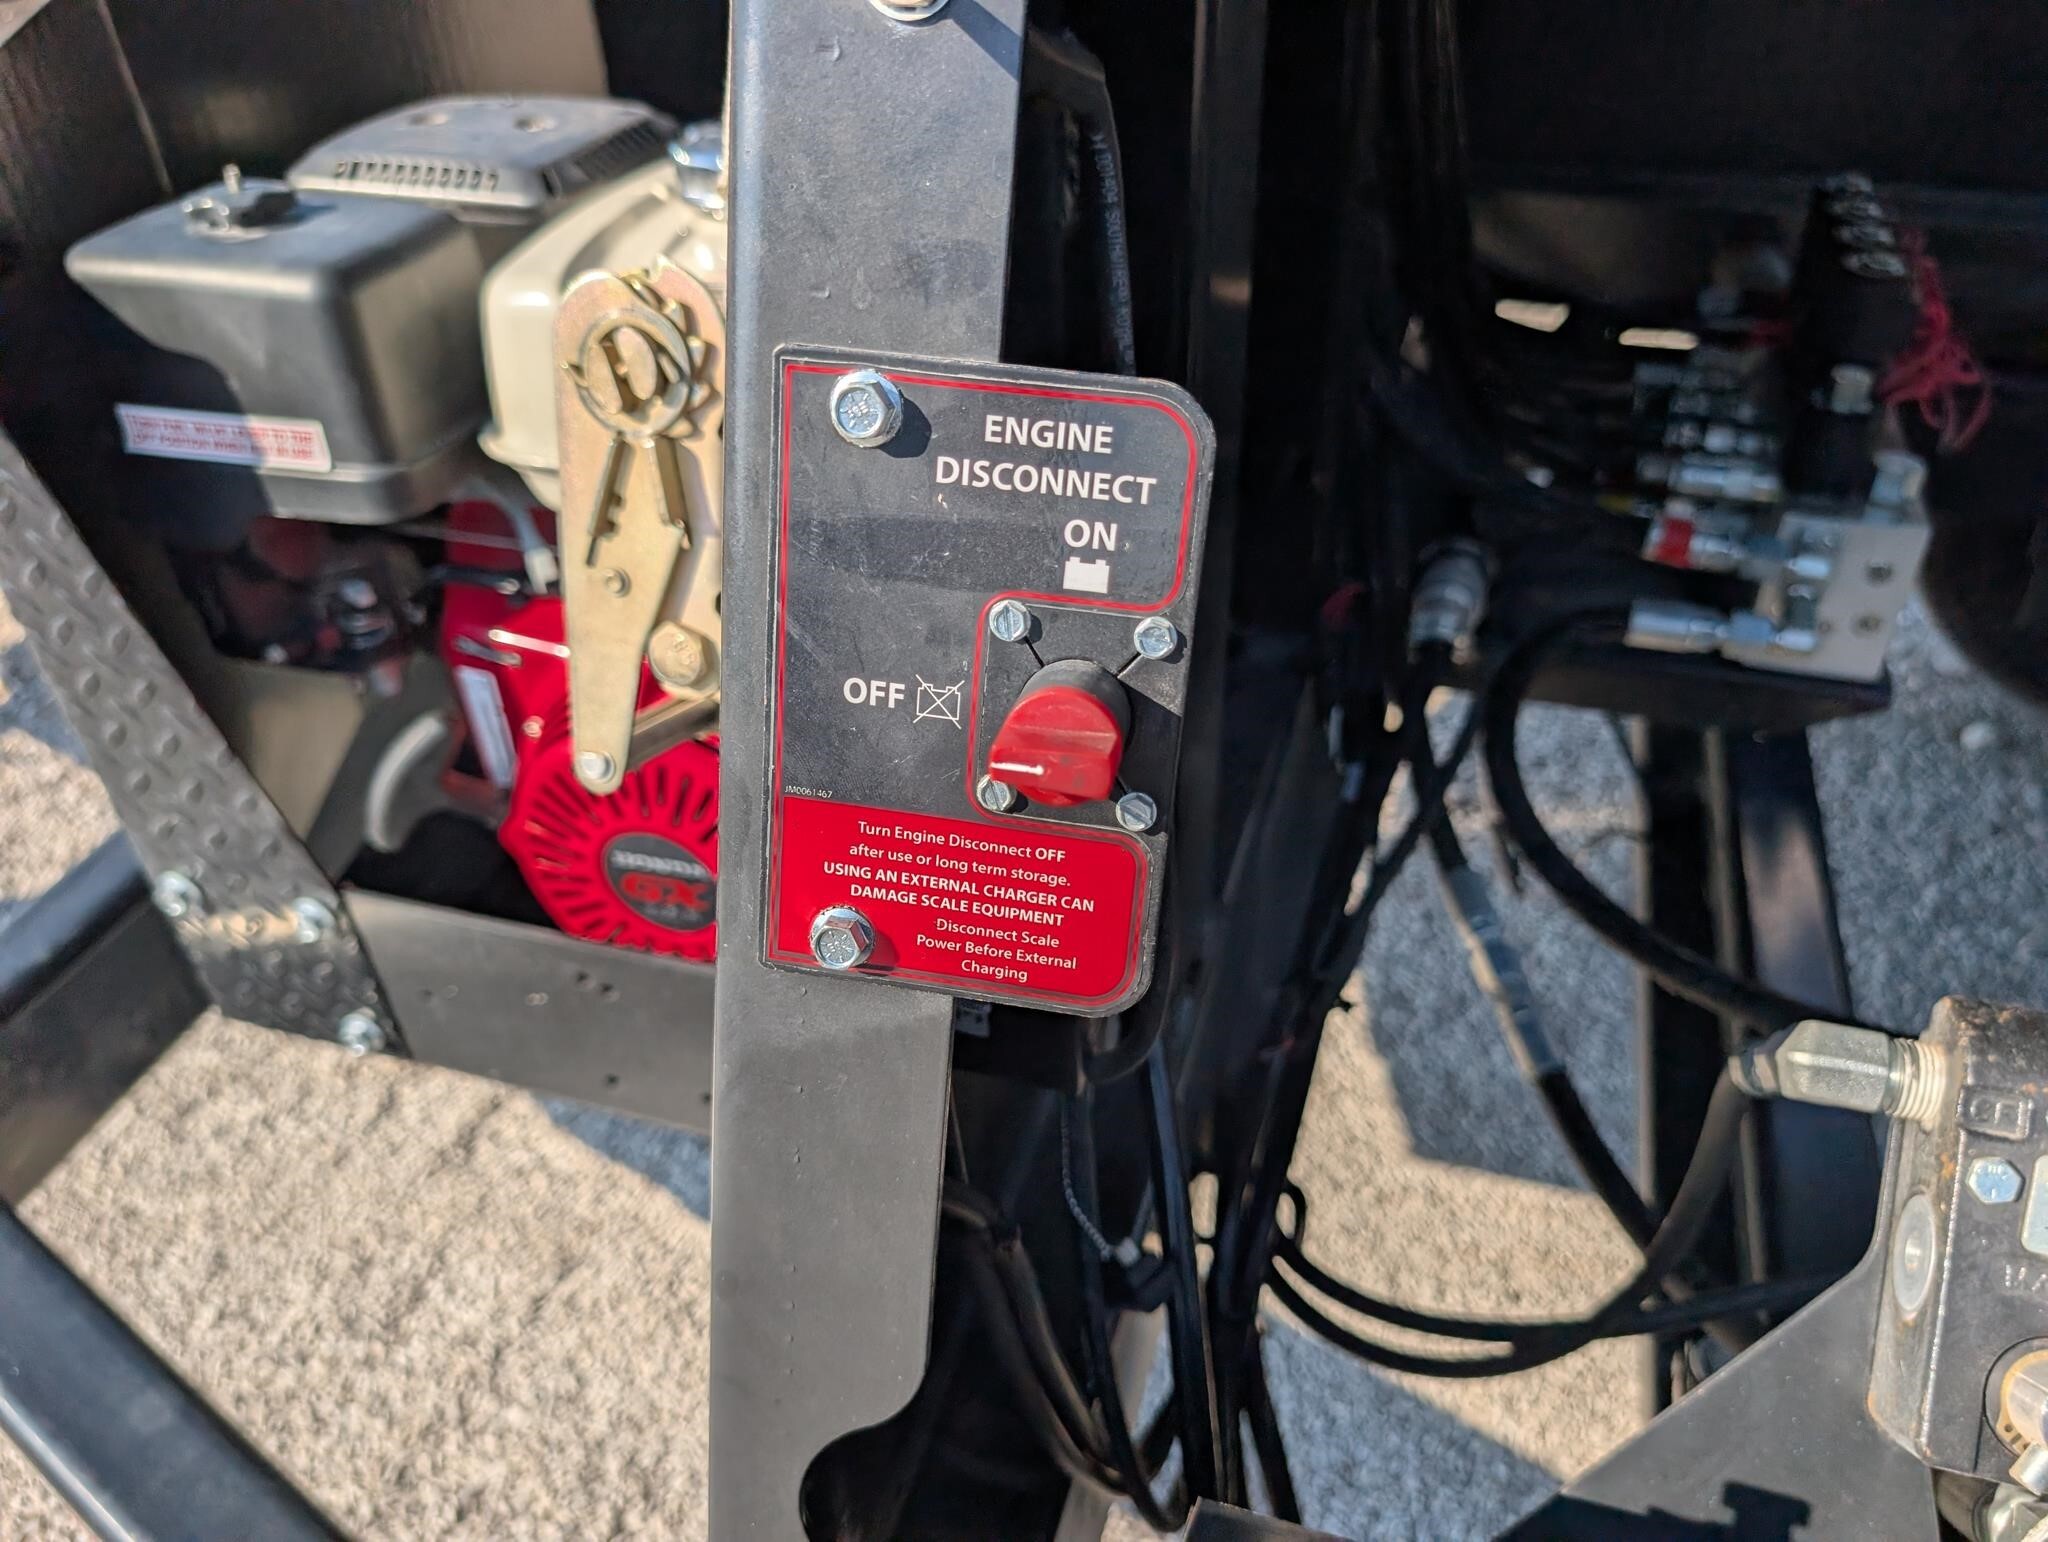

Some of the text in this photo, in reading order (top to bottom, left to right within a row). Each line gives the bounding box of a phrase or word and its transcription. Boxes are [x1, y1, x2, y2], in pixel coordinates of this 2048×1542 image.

[984, 415, 1113, 454] ENGINE
[935, 456, 1157, 504] DISCONNECT
[1063, 519, 1118, 551] ON
[843, 677, 906, 709] OFF
[858, 821, 1065, 862] Turn Engine Disconnect OFF
[850, 843, 1070, 887] after use or long term storage.
[824, 861, 1094, 912] USING AN EXTERNAL CHARGER CAN
[851, 884, 1064, 926] DAMAGE SCALE EQUIPMENT
[917, 934, 1076, 969] Power Before External
[937, 918, 1059, 947] Disconnect Scale
[961, 960, 1027, 983] Charging
